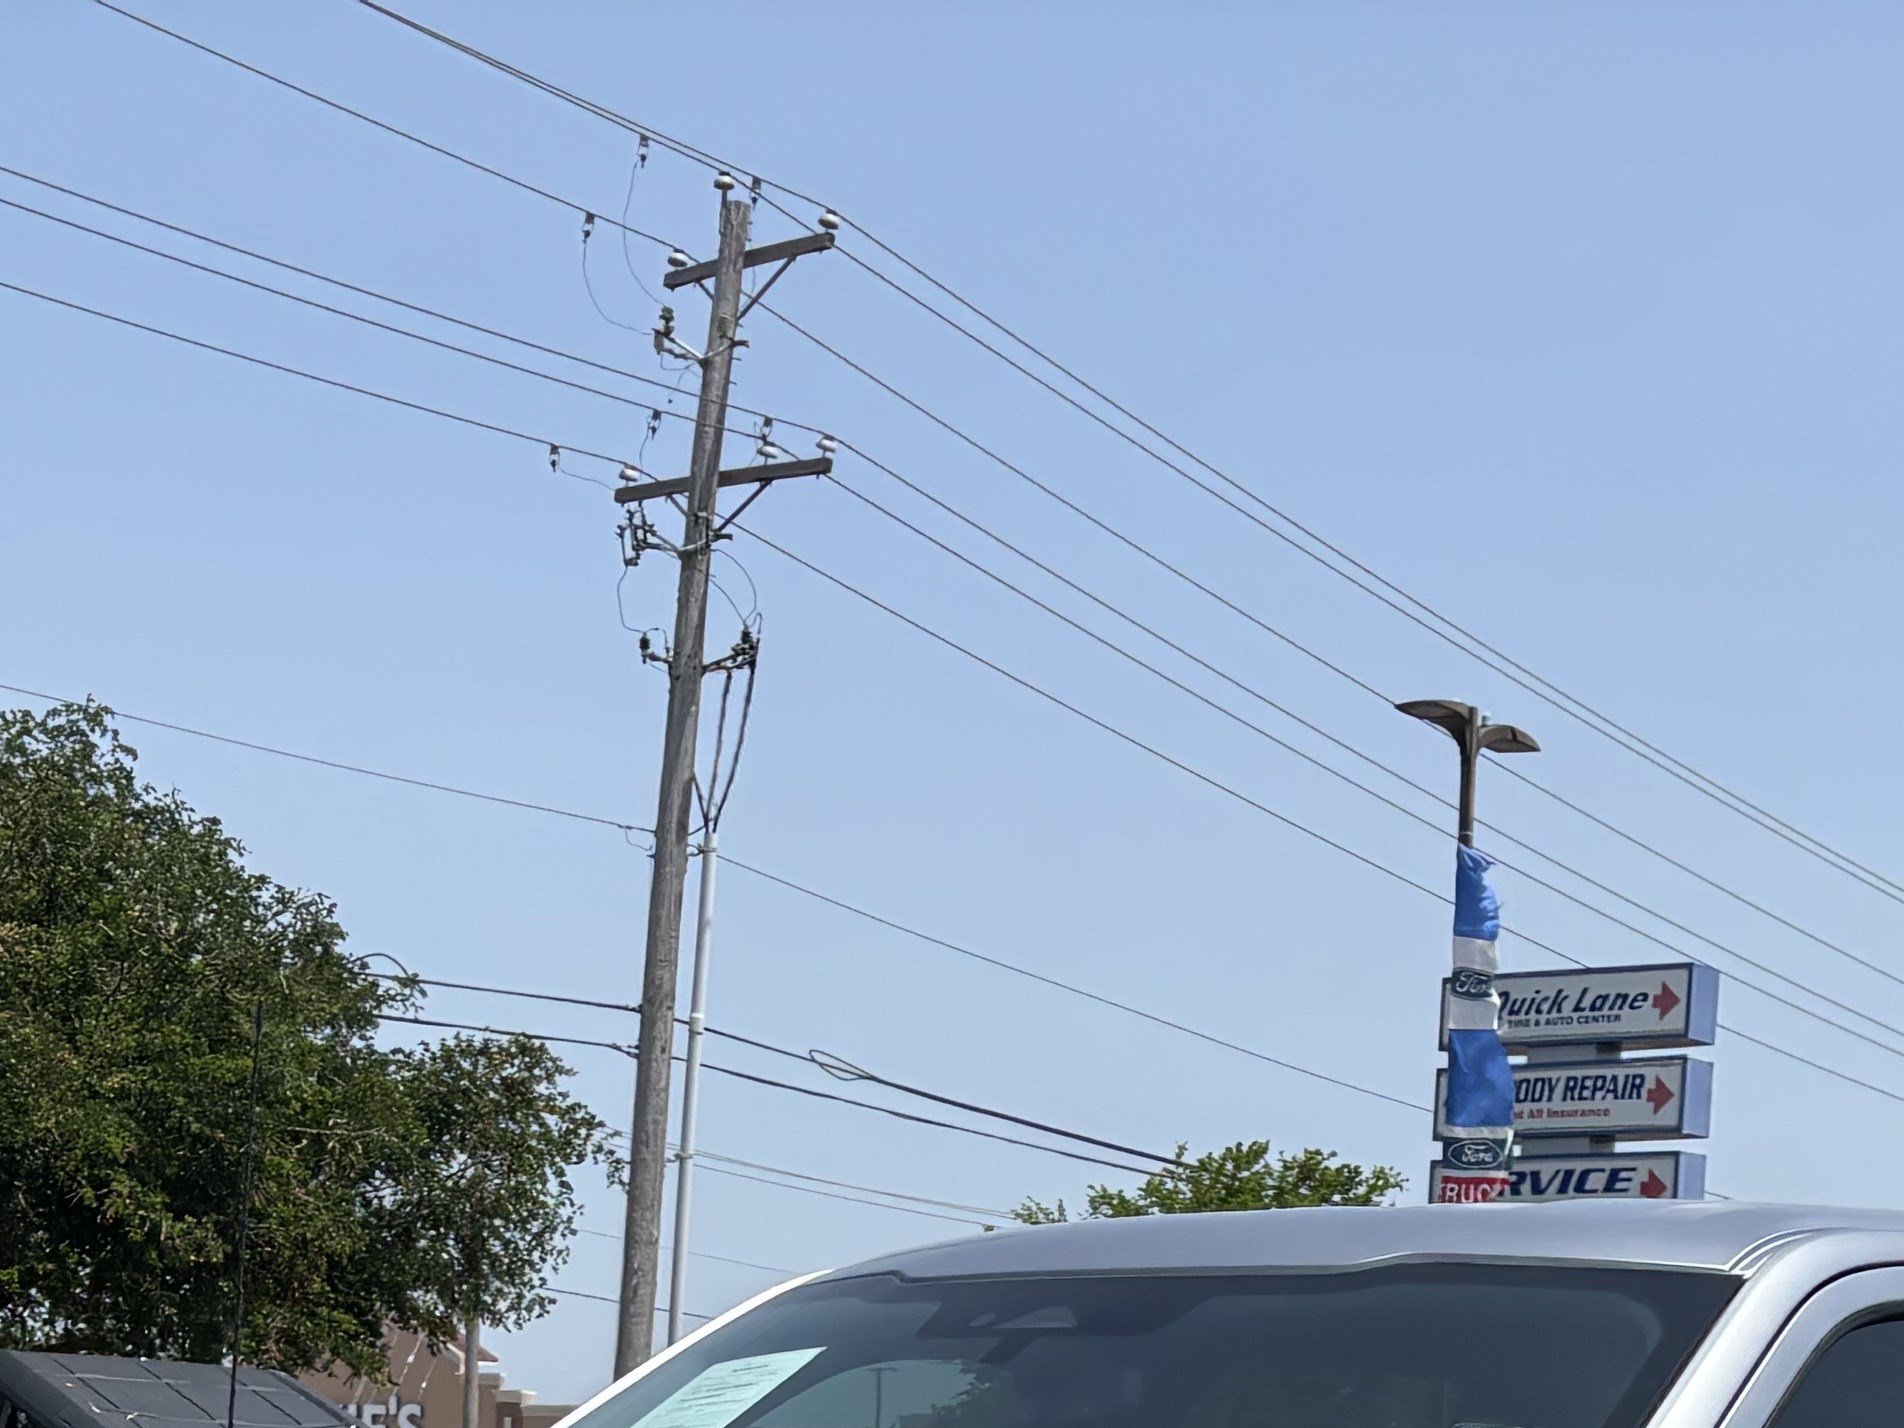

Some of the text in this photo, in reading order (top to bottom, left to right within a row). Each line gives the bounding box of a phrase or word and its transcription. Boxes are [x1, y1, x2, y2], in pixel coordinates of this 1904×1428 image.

[1572, 986, 1649, 1014] Lane
[1507, 1018, 1530, 1029] TIRE
[1546, 1015, 1574, 1026] AUTO
[1577, 1013, 1622, 1025] CENTER
[1562, 1073, 1646, 1101] REPAIR
[1545, 1107, 1612, 1119] Insurance
